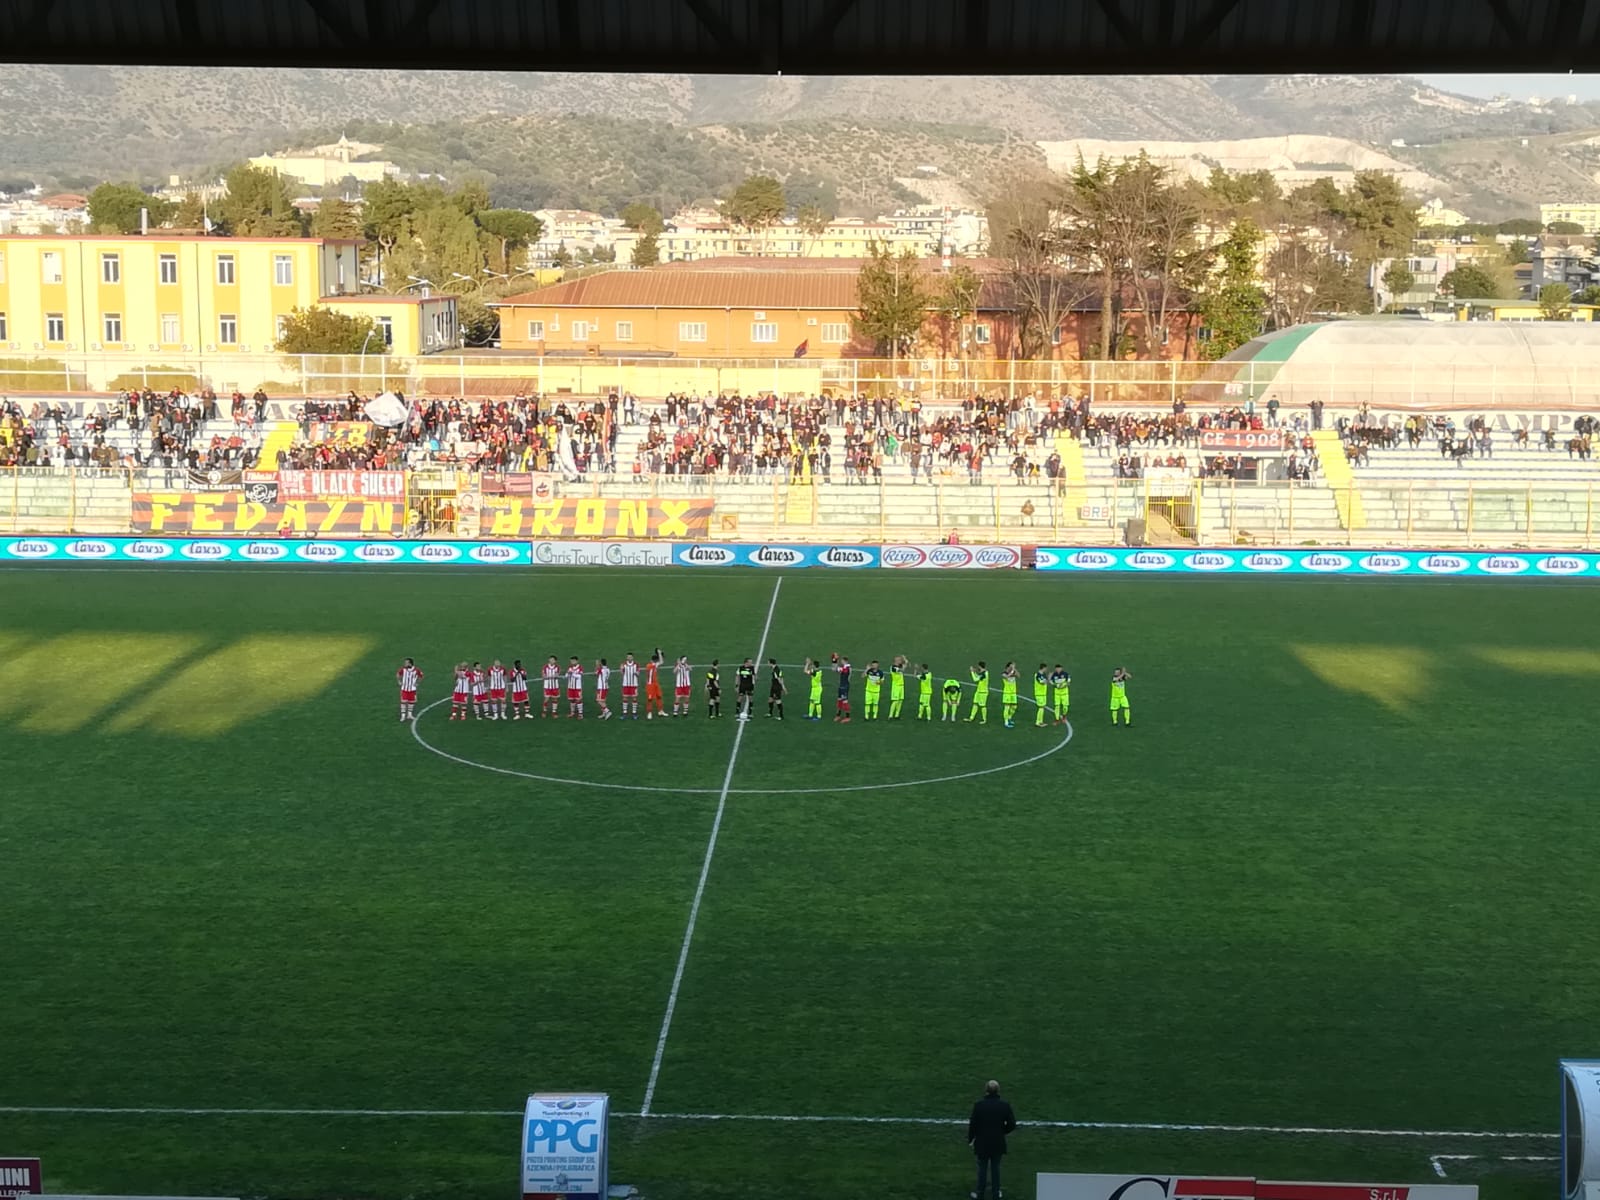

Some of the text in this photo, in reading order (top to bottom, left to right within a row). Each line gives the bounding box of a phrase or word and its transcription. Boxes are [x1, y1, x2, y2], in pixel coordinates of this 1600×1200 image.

[1234, 432, 1280, 448] 1908
[312, 472, 355, 495] BLACK
[361, 472, 403, 496] SHEEP
[150, 494, 394, 531] FEDAYN
[490, 499, 690, 536] BRONX
[884, 550, 921, 564] Rispo
[930, 550, 967, 564] Rispo
[976, 550, 1013, 564] Rispo
[527, 1119, 598, 1153] PPG
